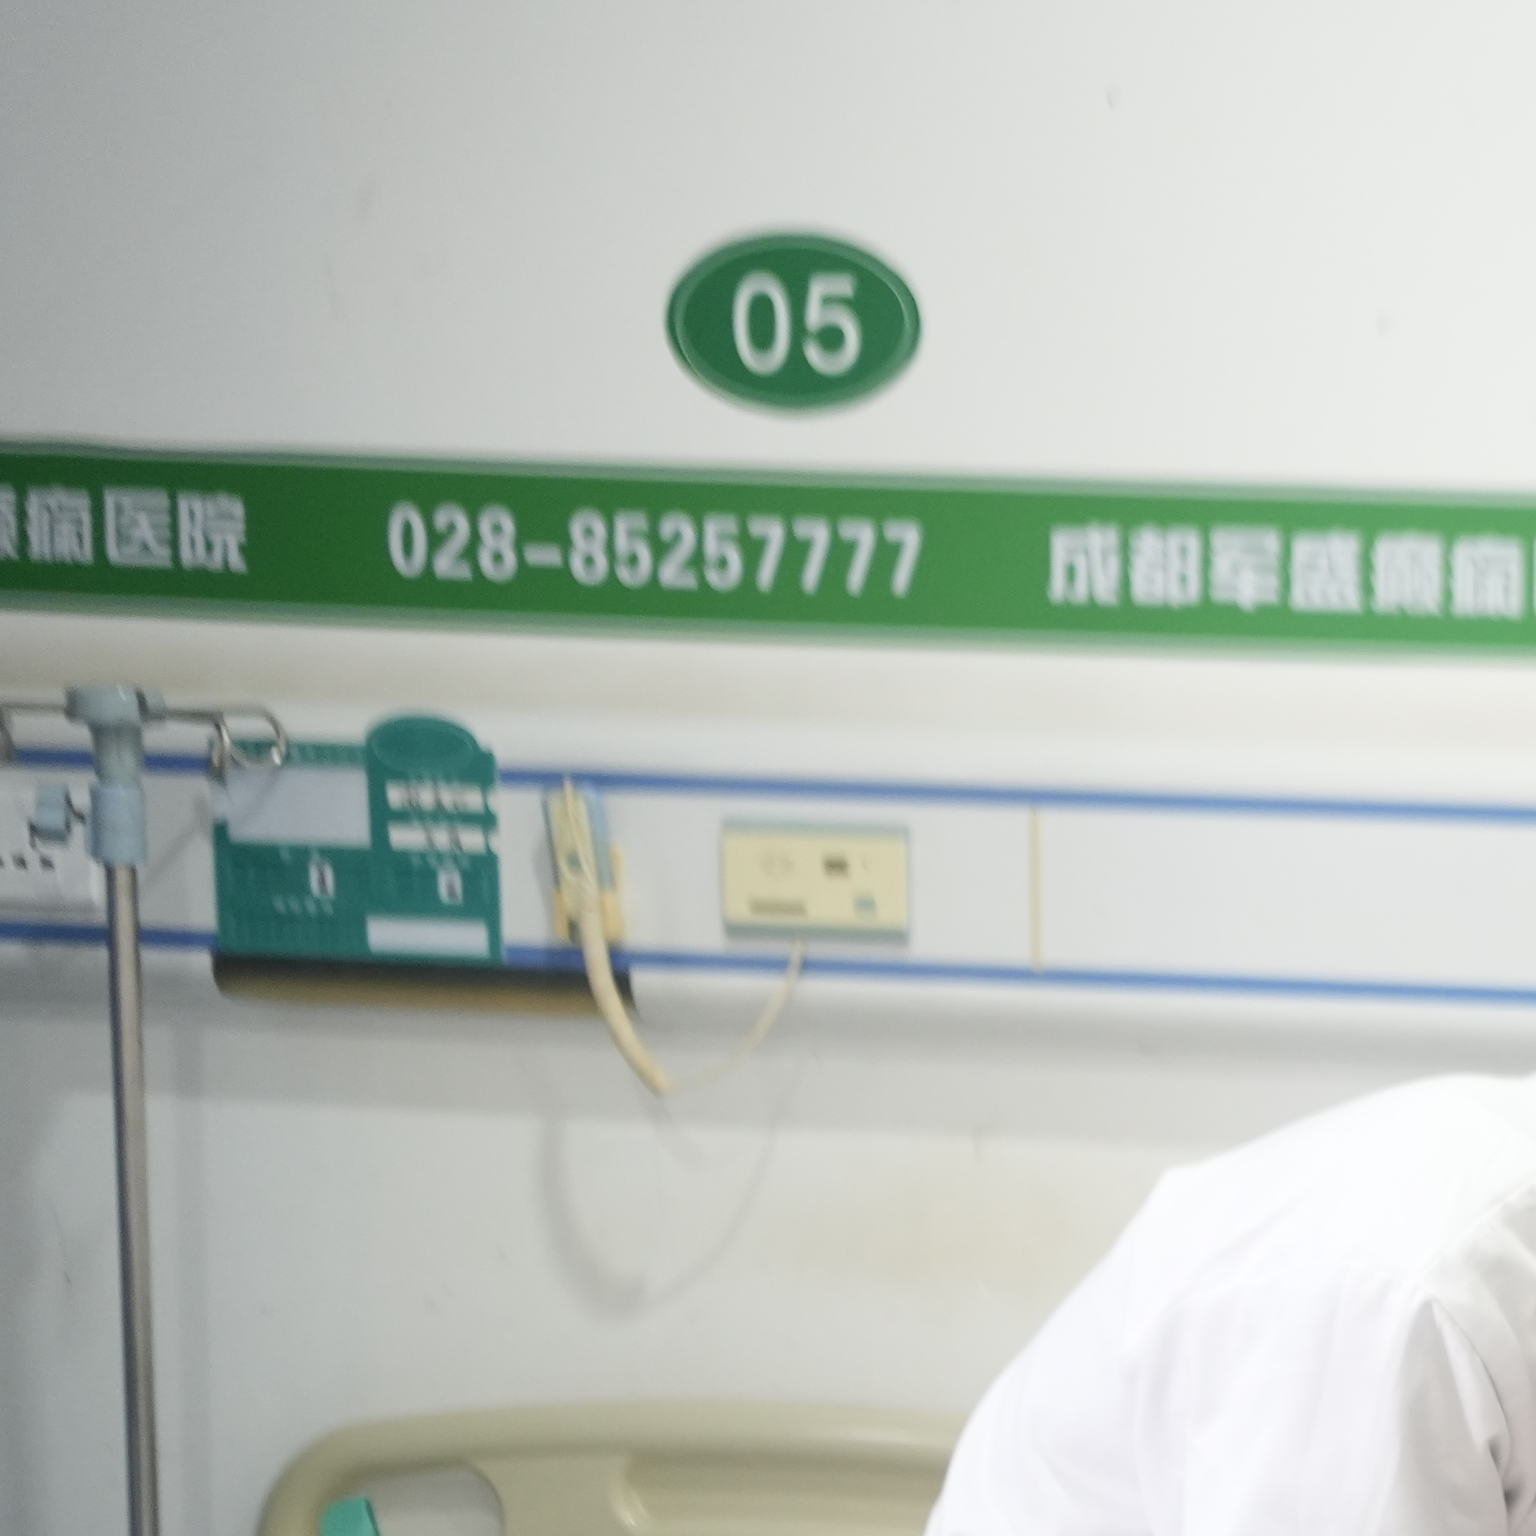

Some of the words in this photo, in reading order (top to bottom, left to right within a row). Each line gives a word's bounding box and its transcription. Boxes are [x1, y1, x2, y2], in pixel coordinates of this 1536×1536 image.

[730, 269, 863, 378] 05
[0, 484, 248, 573] 痫医院
[386, 500, 922, 599] 028-85257777
